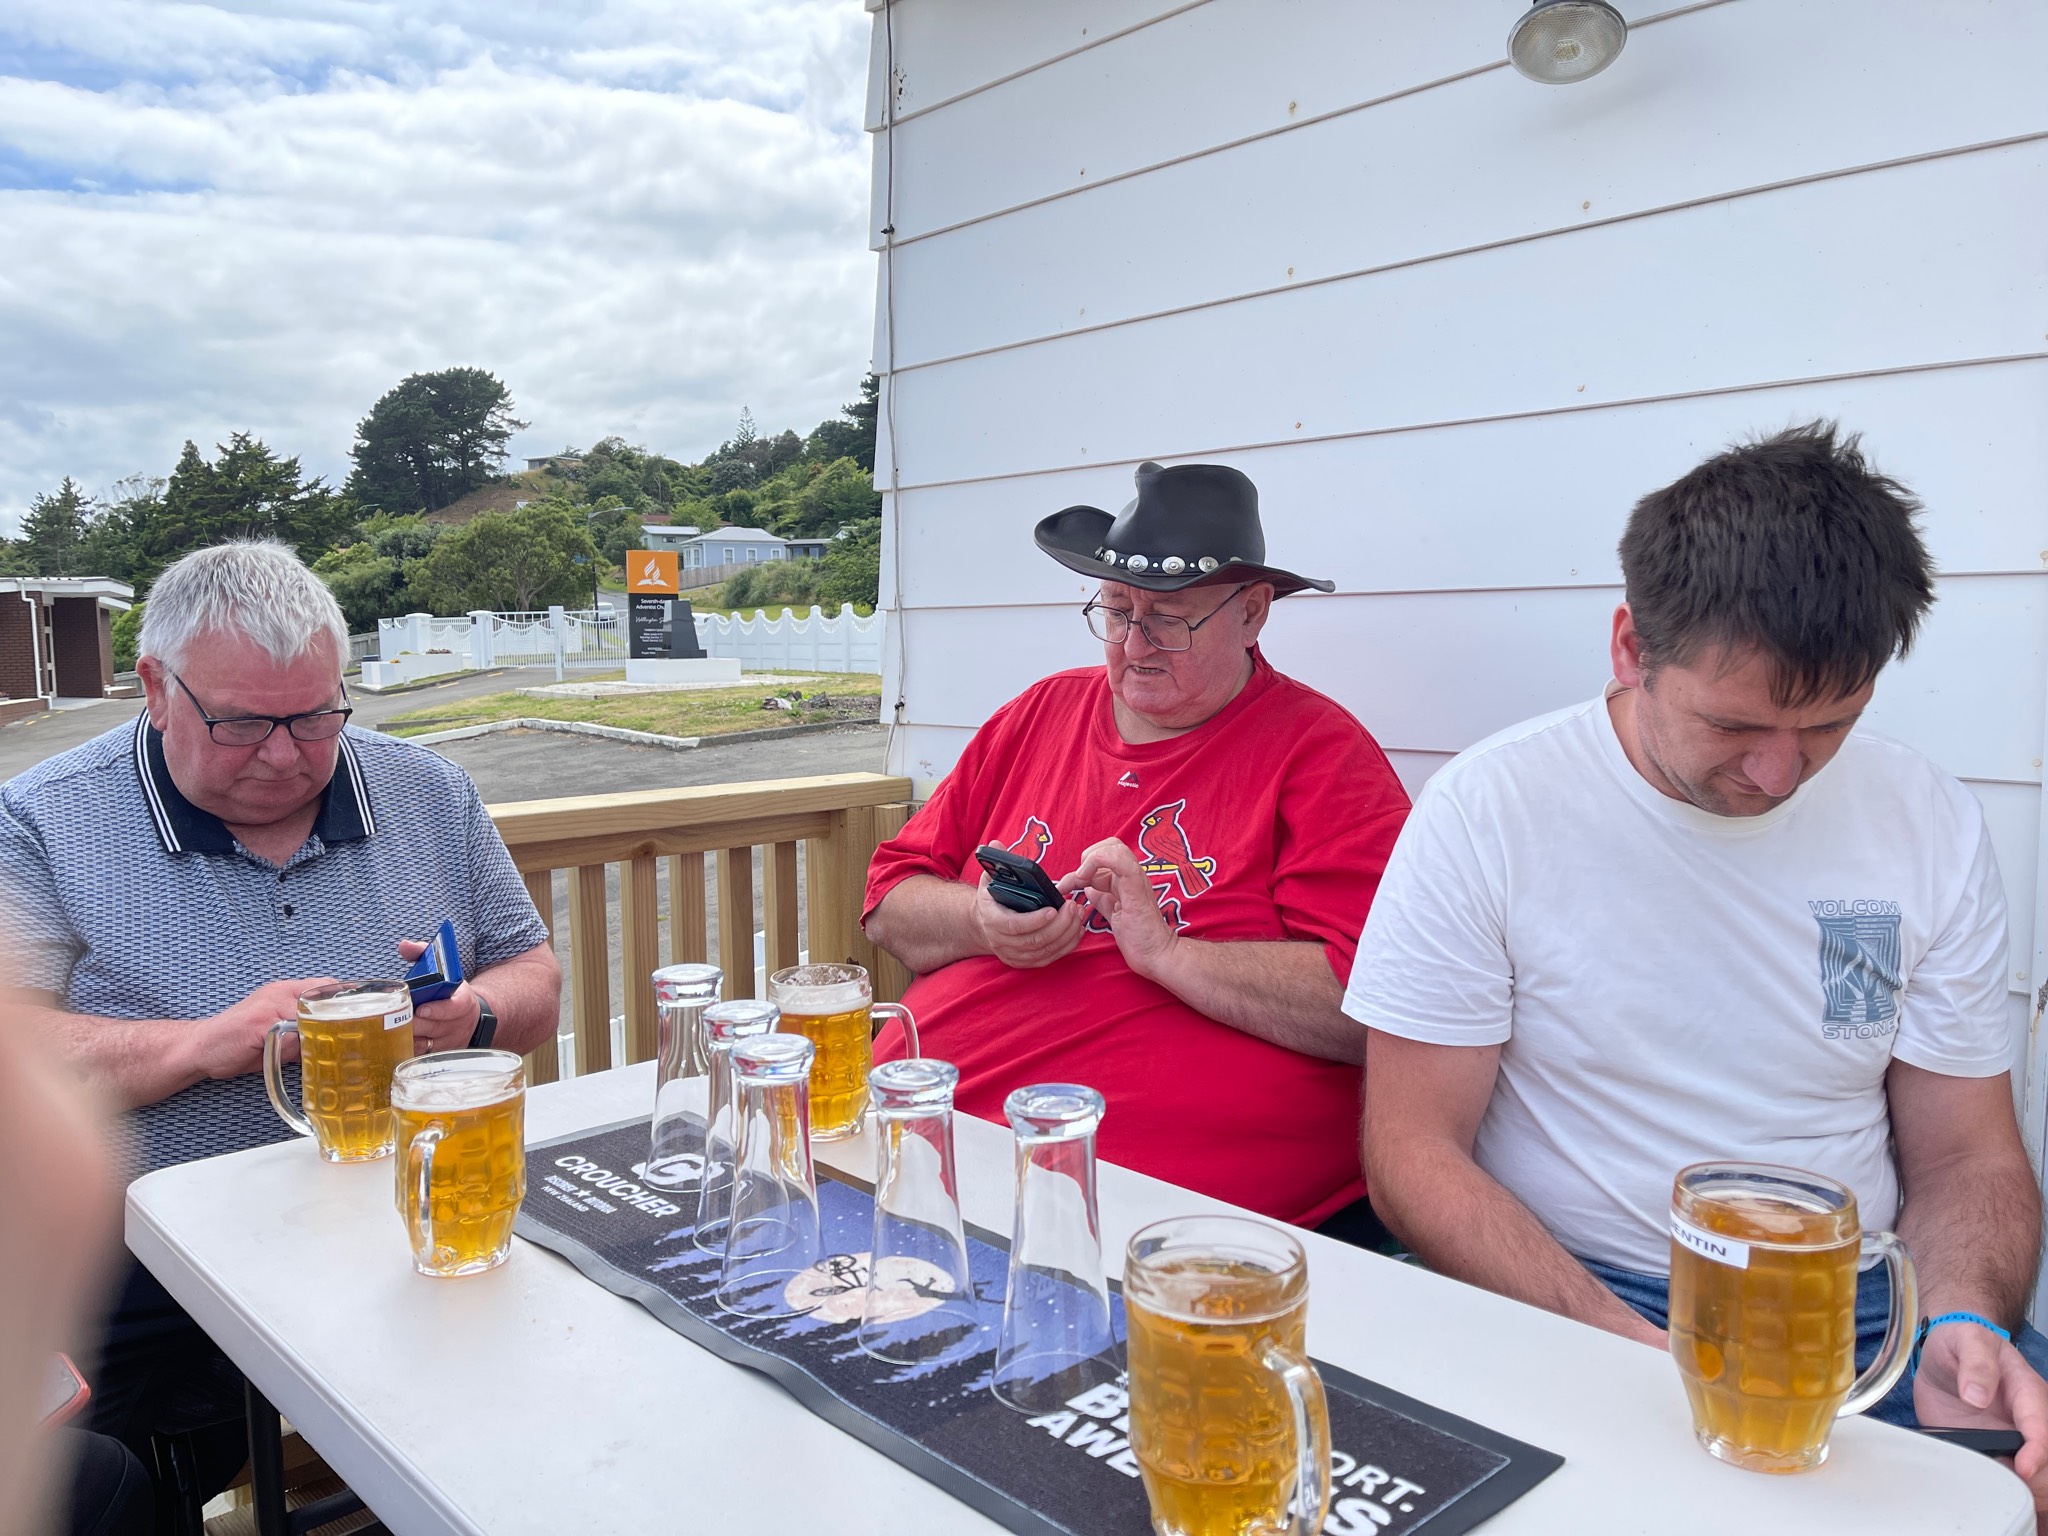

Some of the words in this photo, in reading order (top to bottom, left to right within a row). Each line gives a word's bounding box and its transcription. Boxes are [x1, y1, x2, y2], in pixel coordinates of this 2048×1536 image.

[1808, 900, 1902, 916] VOLCOM
[1821, 1018, 1896, 1040] STONE
[555, 1155, 681, 1218] CROUCHER
